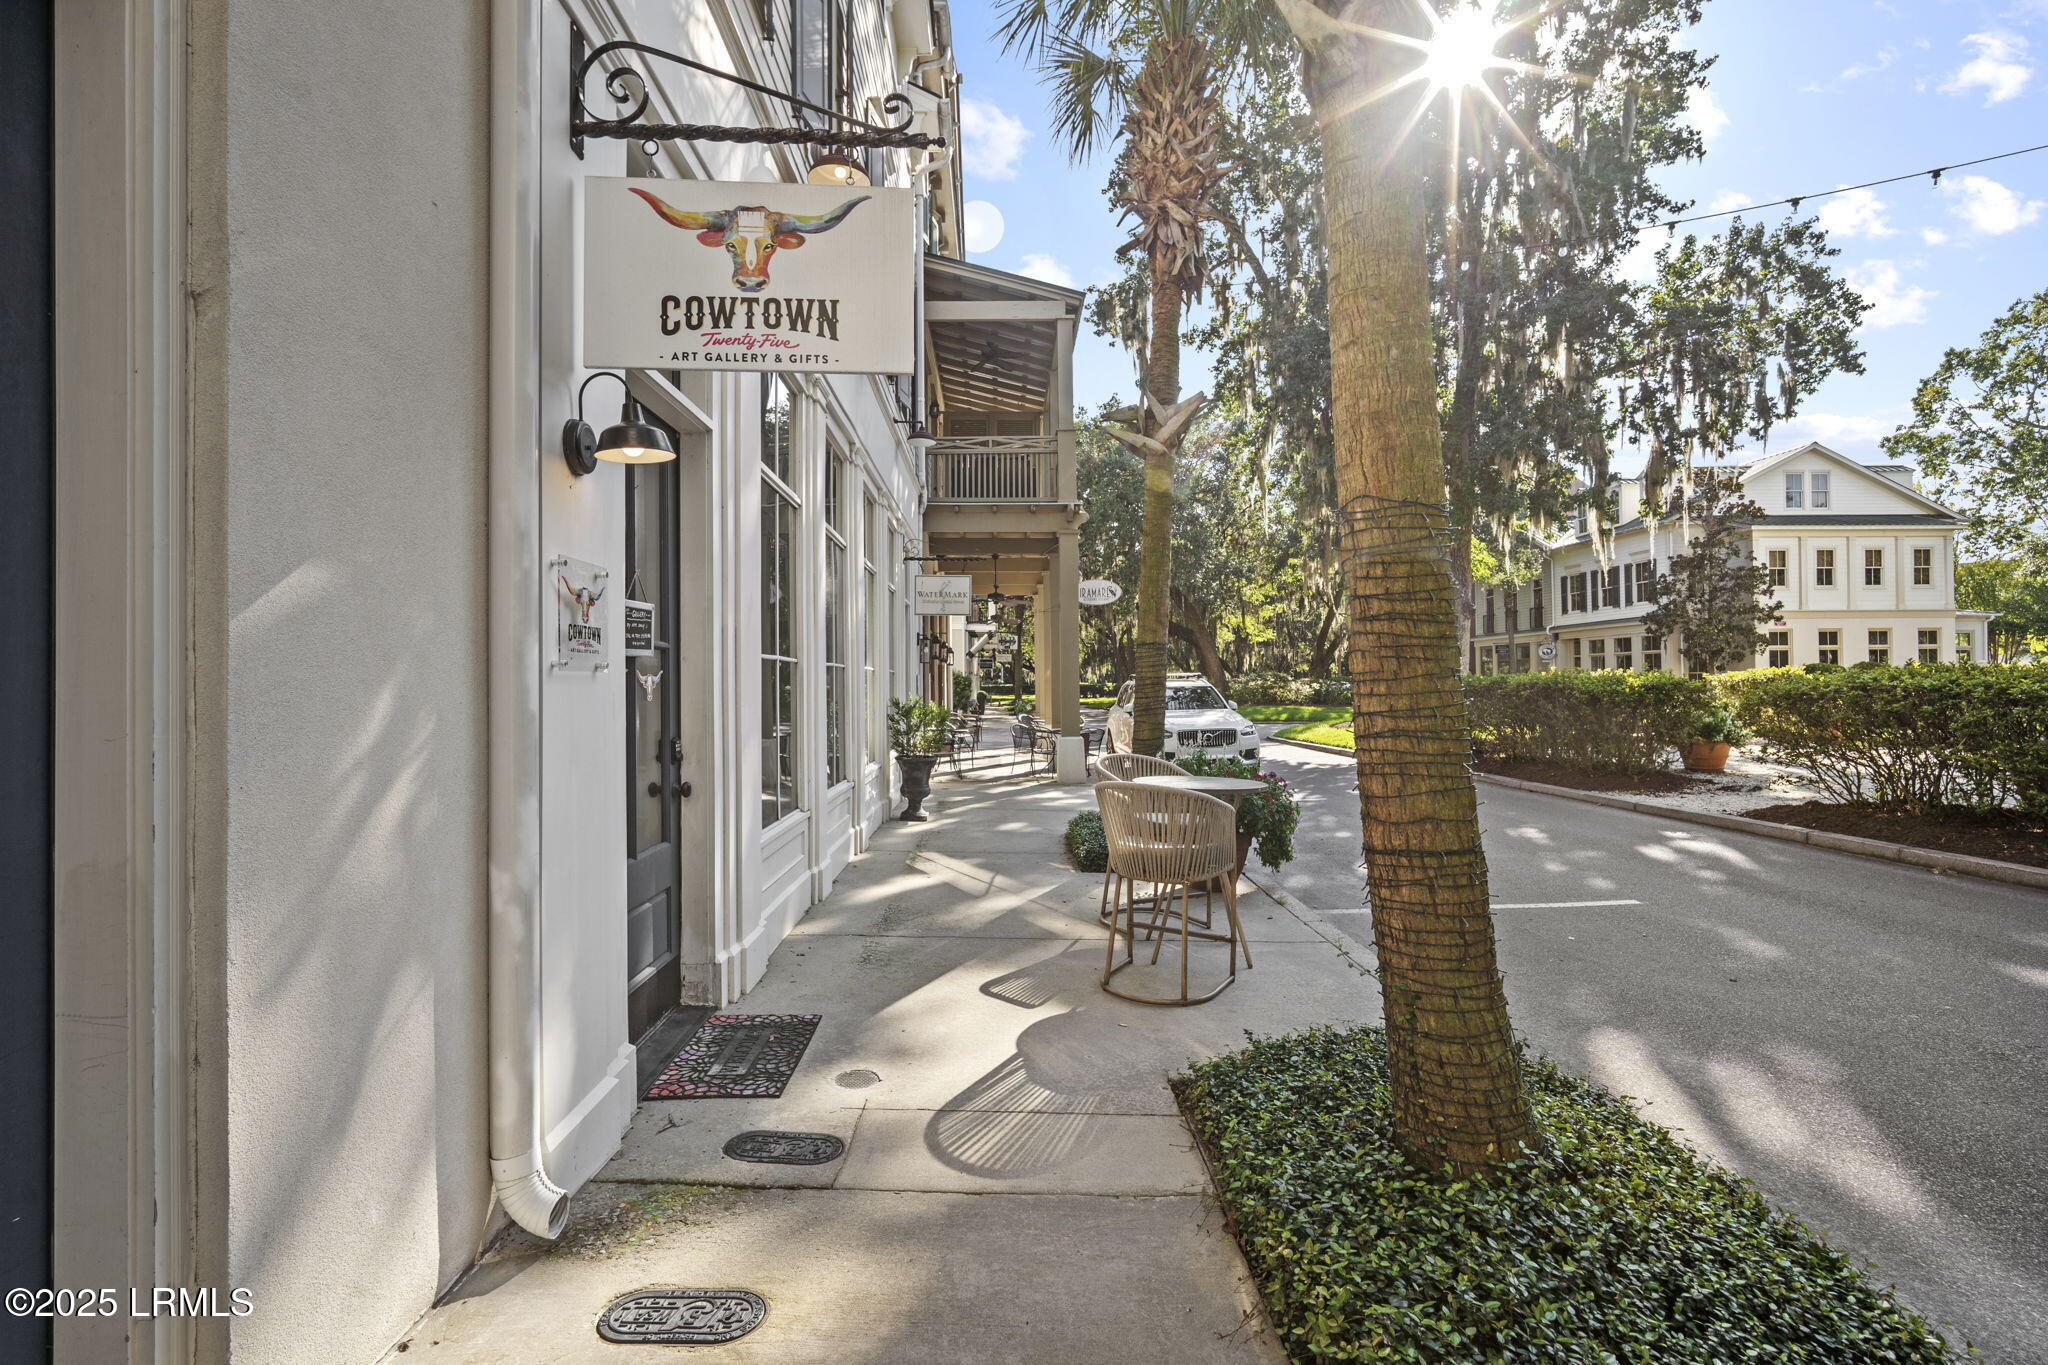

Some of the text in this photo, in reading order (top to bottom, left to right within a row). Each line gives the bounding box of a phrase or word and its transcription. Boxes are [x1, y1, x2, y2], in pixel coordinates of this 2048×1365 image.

[659, 294, 840, 342] COWTOWN
[700, 332, 800, 351] Twenty-Five
[671, 351, 829, 364] ART GALLERY & GIFTS
[917, 591, 968, 599] WATERMARK
[568, 624, 601, 645] COWTOWN
